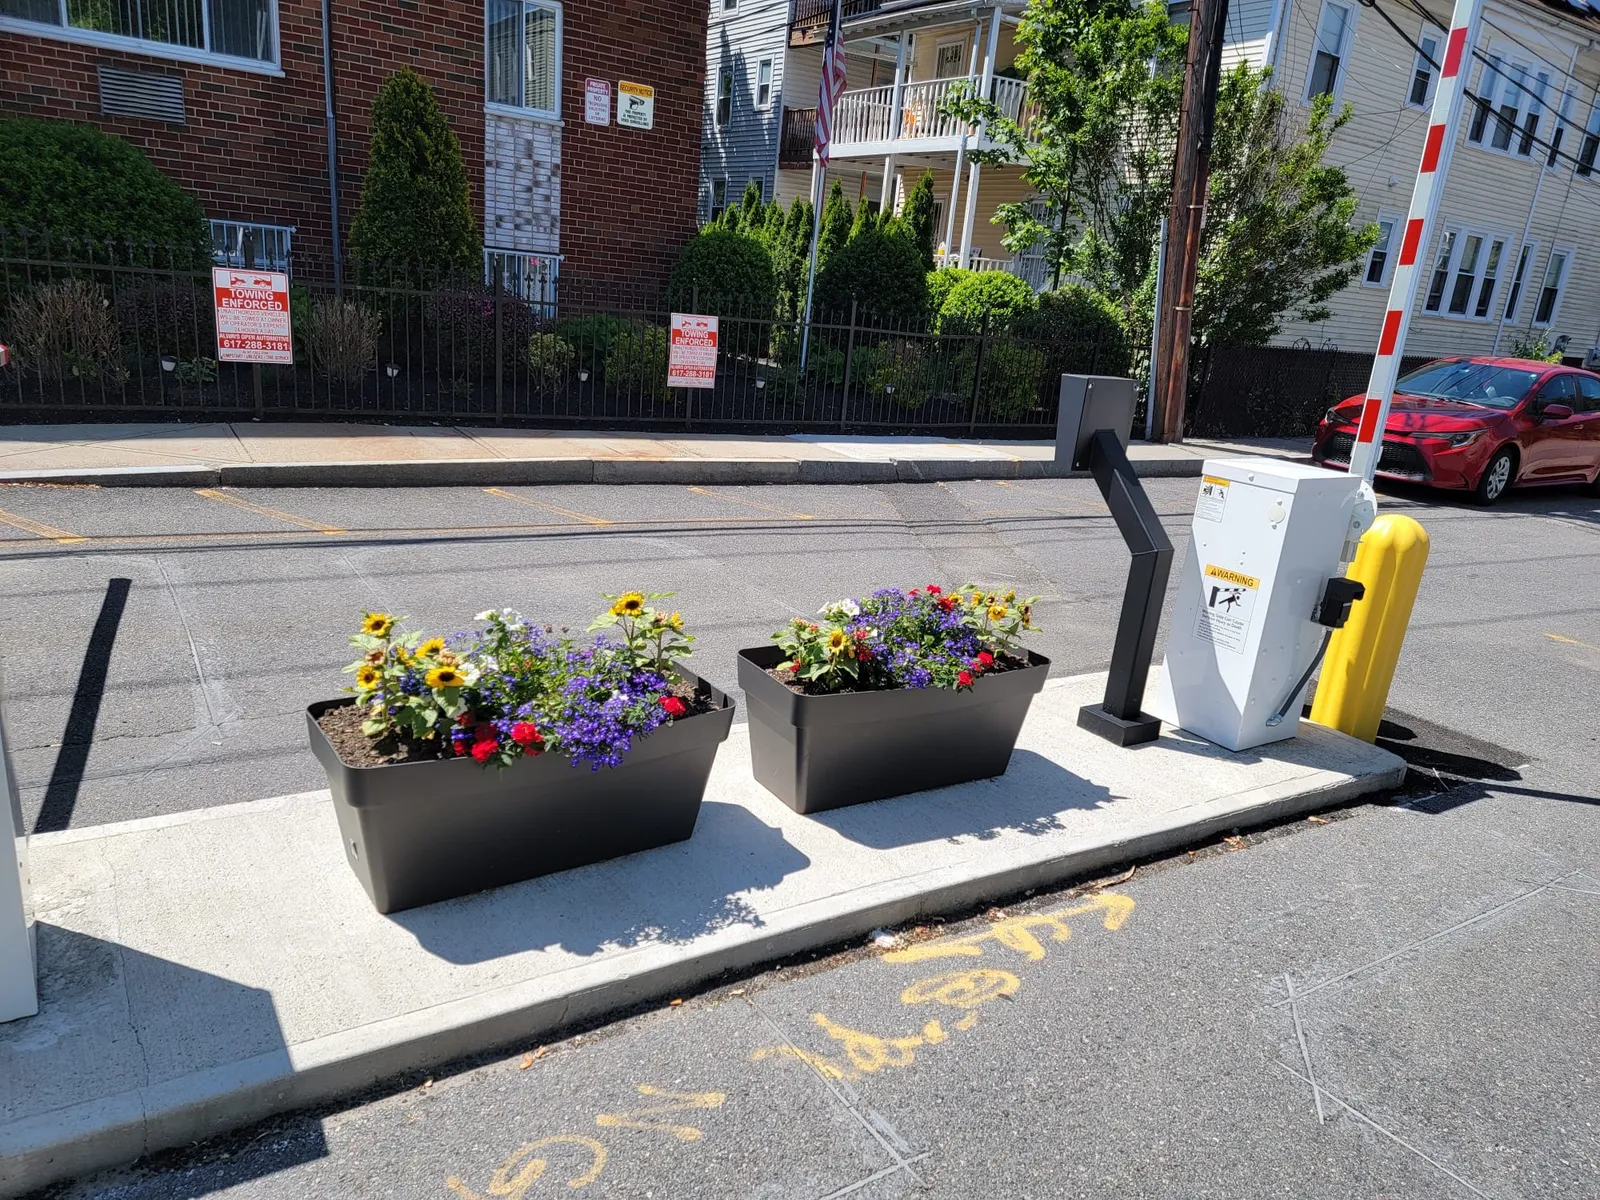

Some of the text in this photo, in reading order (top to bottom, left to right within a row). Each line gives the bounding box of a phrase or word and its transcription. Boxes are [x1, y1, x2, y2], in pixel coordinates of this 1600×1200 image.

[621, 84, 639, 92] SECURITY
[230, 289, 274, 300] TOWING
[222, 298, 282, 310] ENFORCED
[681, 330, 709, 338] TOWING
[224, 339, 288, 350] 617-288-3181
[676, 337, 713, 346] ENFORCED
[672, 370, 713, 378] 617-288-3181
[1217, 569, 1254, 587] WARNING
